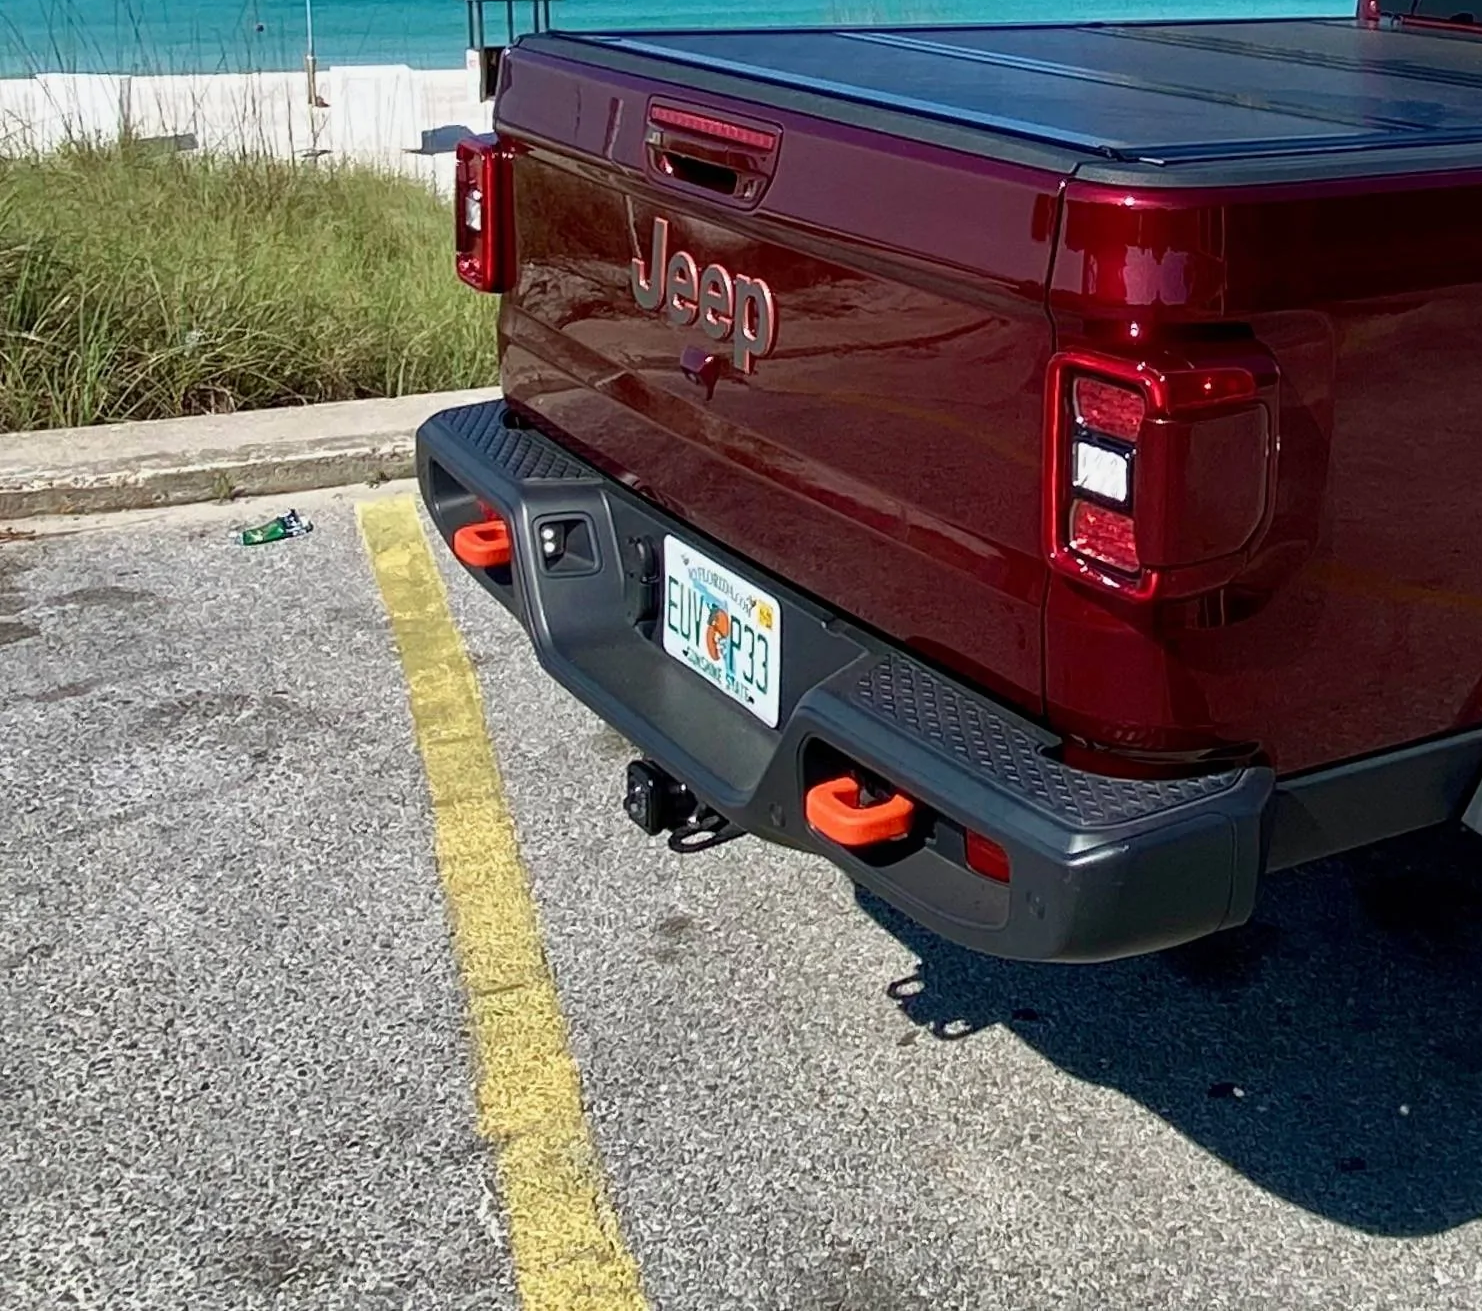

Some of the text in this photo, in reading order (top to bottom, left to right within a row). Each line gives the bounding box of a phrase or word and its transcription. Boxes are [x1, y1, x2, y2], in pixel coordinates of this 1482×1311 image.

[631, 217, 775, 374] Jeep
[668, 575, 704, 648] EUV
[730, 615, 768, 696] P33
